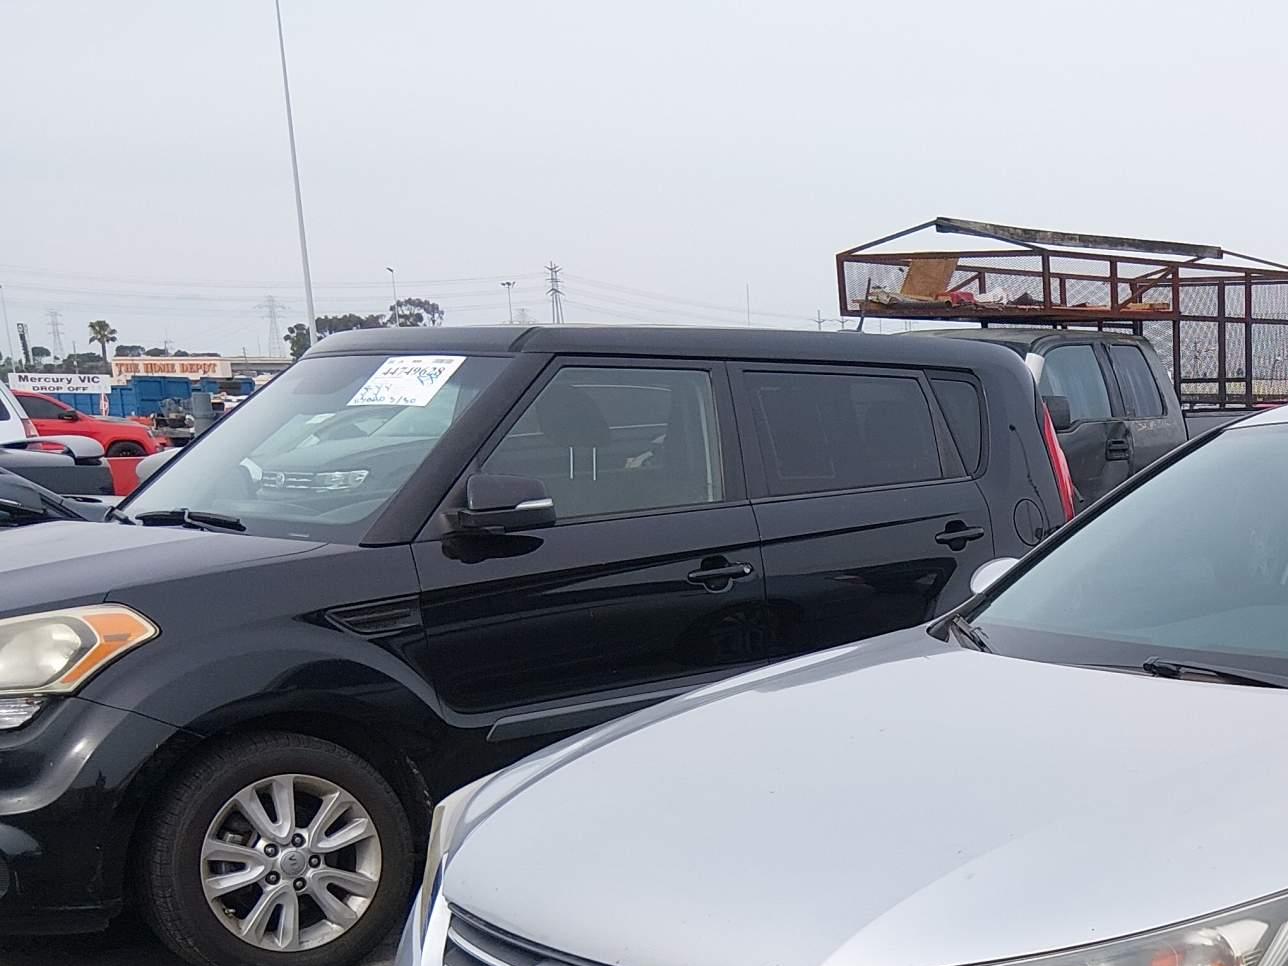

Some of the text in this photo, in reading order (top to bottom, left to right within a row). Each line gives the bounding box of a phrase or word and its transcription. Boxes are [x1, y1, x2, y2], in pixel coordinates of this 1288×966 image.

[116, 363, 218, 373] THE HOME DEPOT
[18, 374, 101, 384] Mercury VIC
